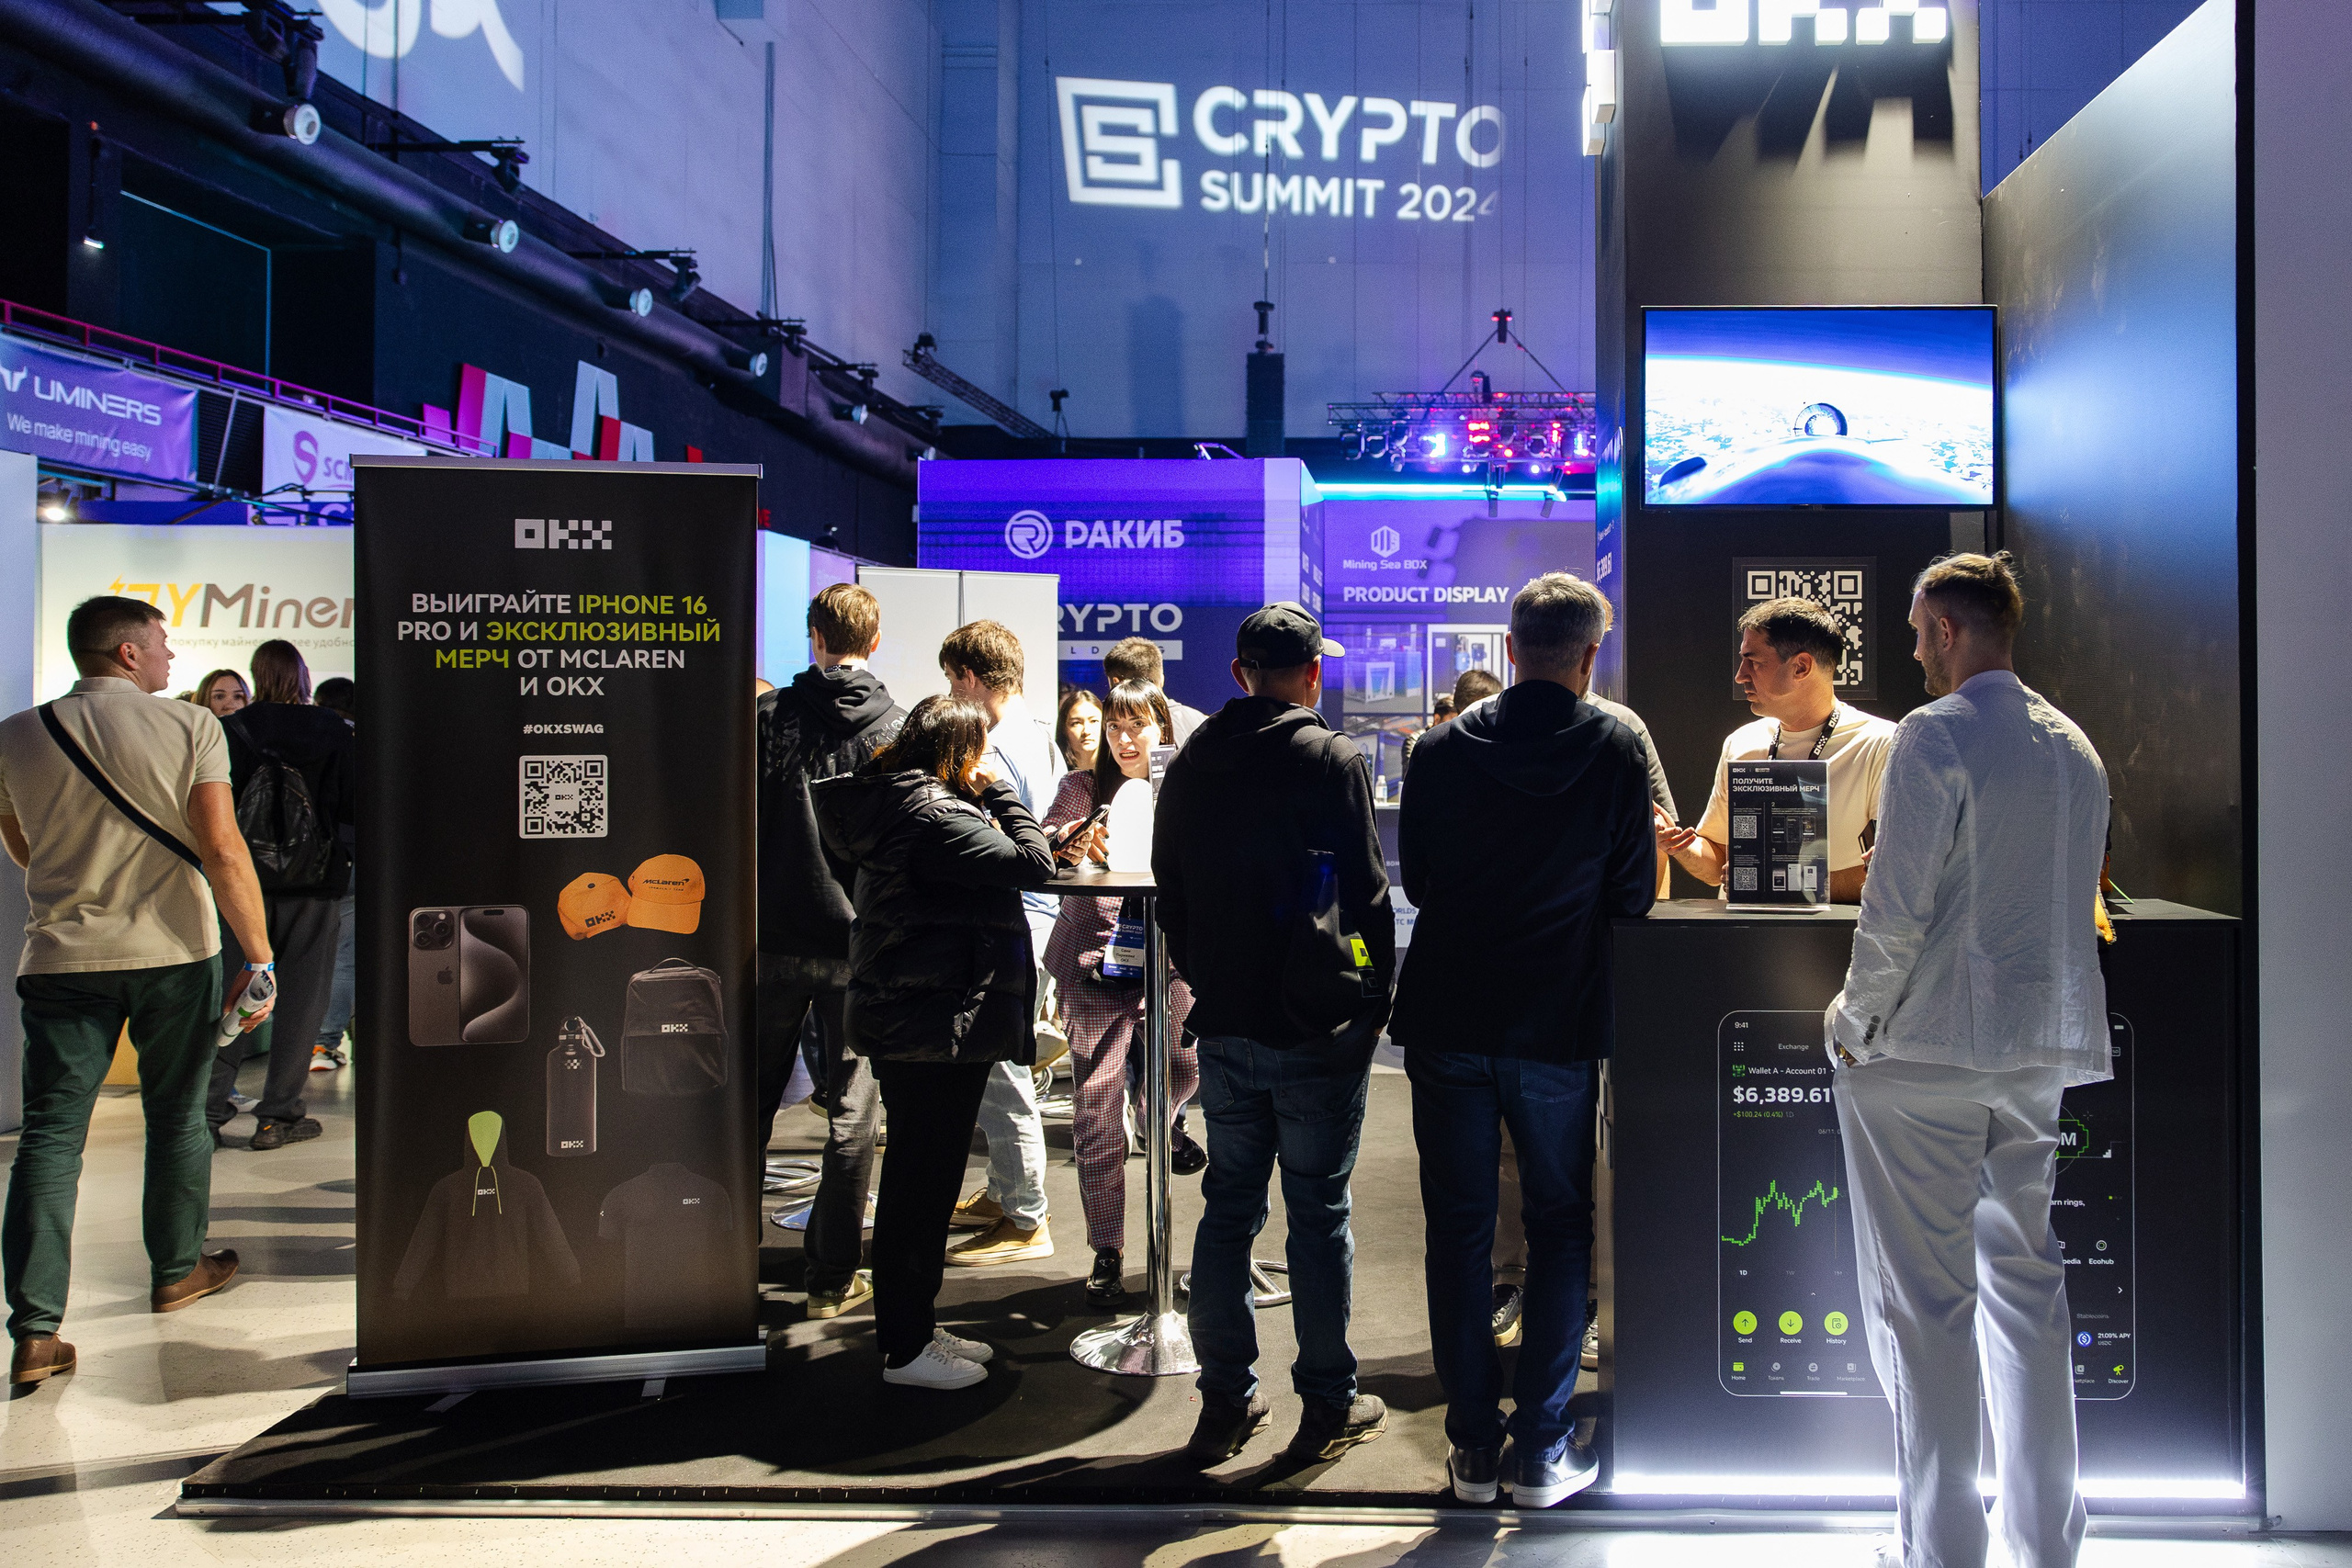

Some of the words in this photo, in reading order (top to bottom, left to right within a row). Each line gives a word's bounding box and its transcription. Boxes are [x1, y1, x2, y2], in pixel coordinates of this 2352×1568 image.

[1193, 85, 1508, 168] CRYPTO
[1201, 169, 1385, 218] SUMMIT
[34, 375, 162, 426] UMINERS
[7, 412, 32, 434] We
[34, 420, 74, 444] make
[75, 430, 121, 457] mining
[514, 518, 613, 550] OKX
[1065, 519, 1185, 549] РАКИБ
[1342, 558, 1378, 571] Mining
[1380, 559, 1402, 570] Sea
[412, 590, 571, 614] ВЫИГРАЙТЕ
[578, 594, 674, 615] IPHONE
[682, 595, 707, 615] 16
[1343, 586, 1427, 603] PRODUCT
[1433, 586, 1510, 604] DISPLAY
[398, 621, 452, 641] PRO
[460, 621, 478, 641] И
[486, 618, 720, 642] ЭКСКЛЮЗИВНЫЙ
[435, 649, 509, 669] МЕРЧ
[517, 649, 553, 669] ОТ
[560, 649, 685, 669] MCLAREN
[520, 676, 538, 696] И
[546, 676, 605, 696] OKX
[523, 723, 605, 735] #OKXSWAG
[1732, 784, 1798, 793] ЭКСКЛЮЗИВНЫЙ
[661, 1023, 688, 1033] OKX
[1778, 1043, 1810, 1052] Exchange
[1733, 1085, 1831, 1105] $6,389.61
[560, 1140, 583, 1148] OKX
[2064, 1198, 2086, 1208] rings,
